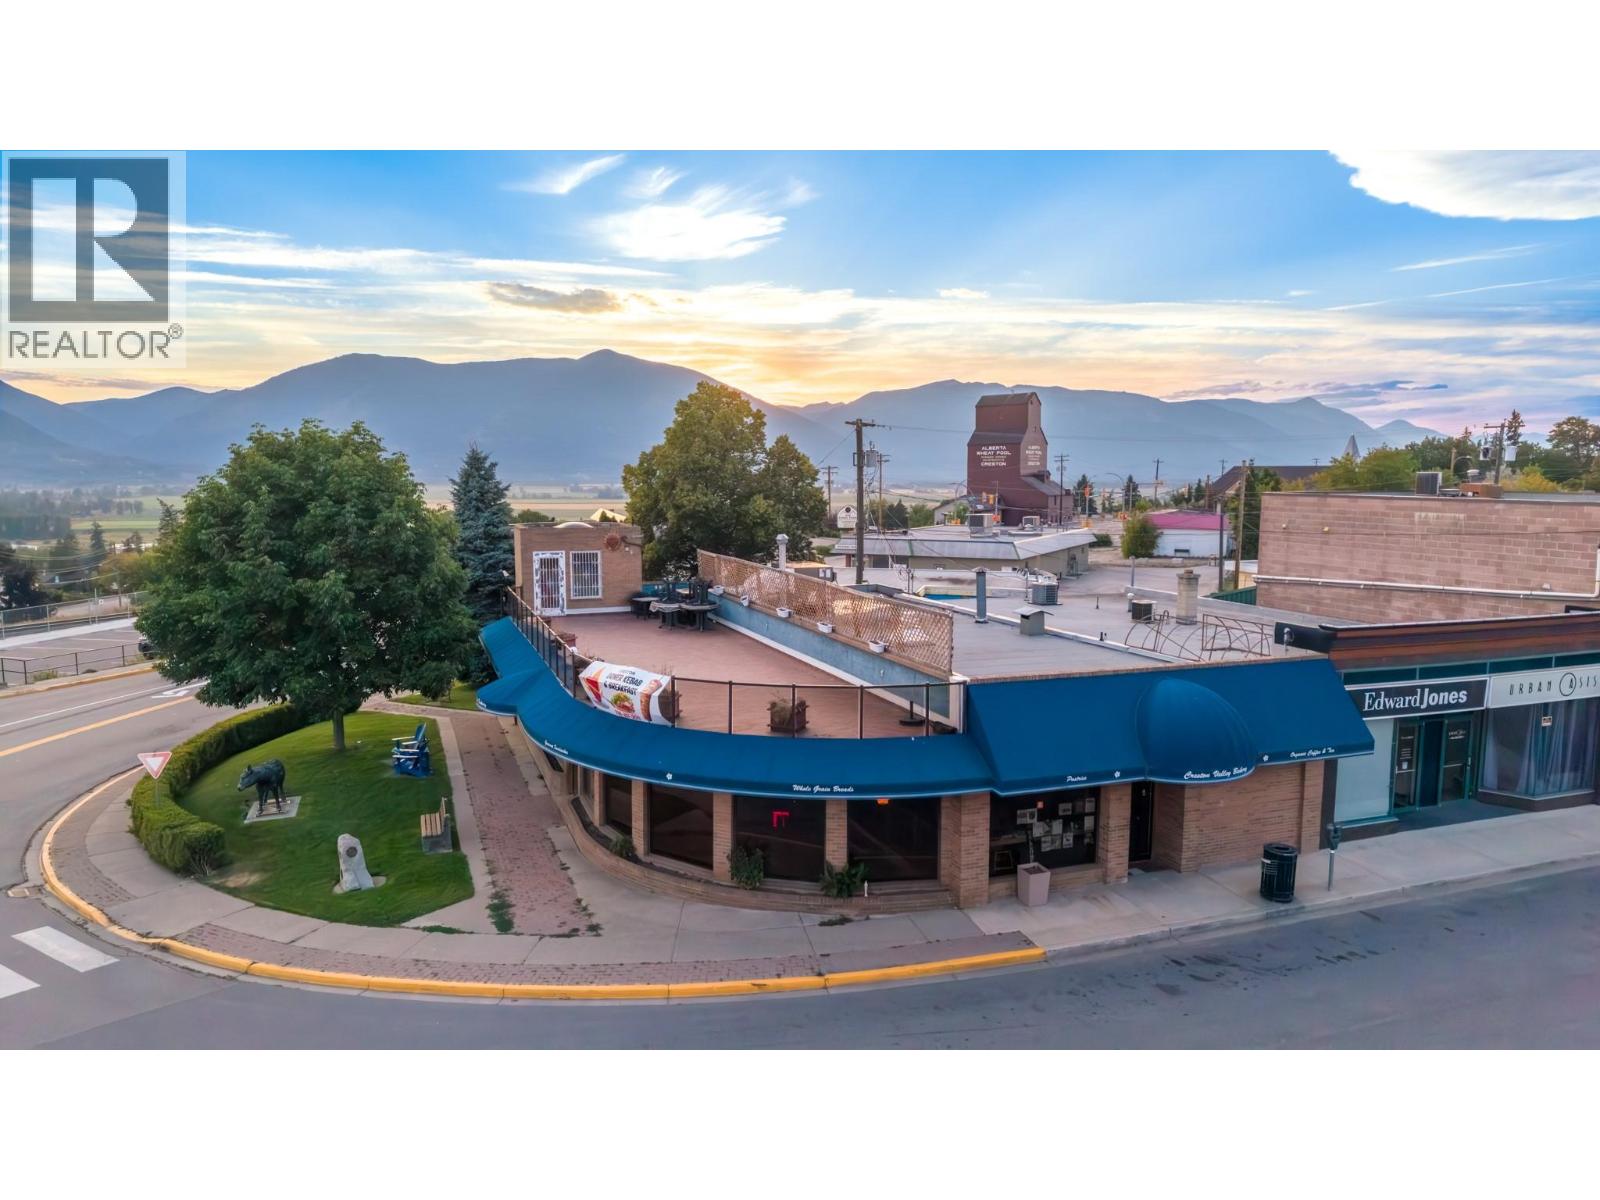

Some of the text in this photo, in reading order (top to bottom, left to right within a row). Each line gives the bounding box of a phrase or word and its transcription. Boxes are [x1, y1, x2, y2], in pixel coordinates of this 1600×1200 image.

[623, 675, 644, 687] KEBAB
[608, 683, 637, 695] BREAKFAST
[1509, 680, 1552, 696] URBAN
[1183, 766, 1248, 779] Creston Valley Bakery
